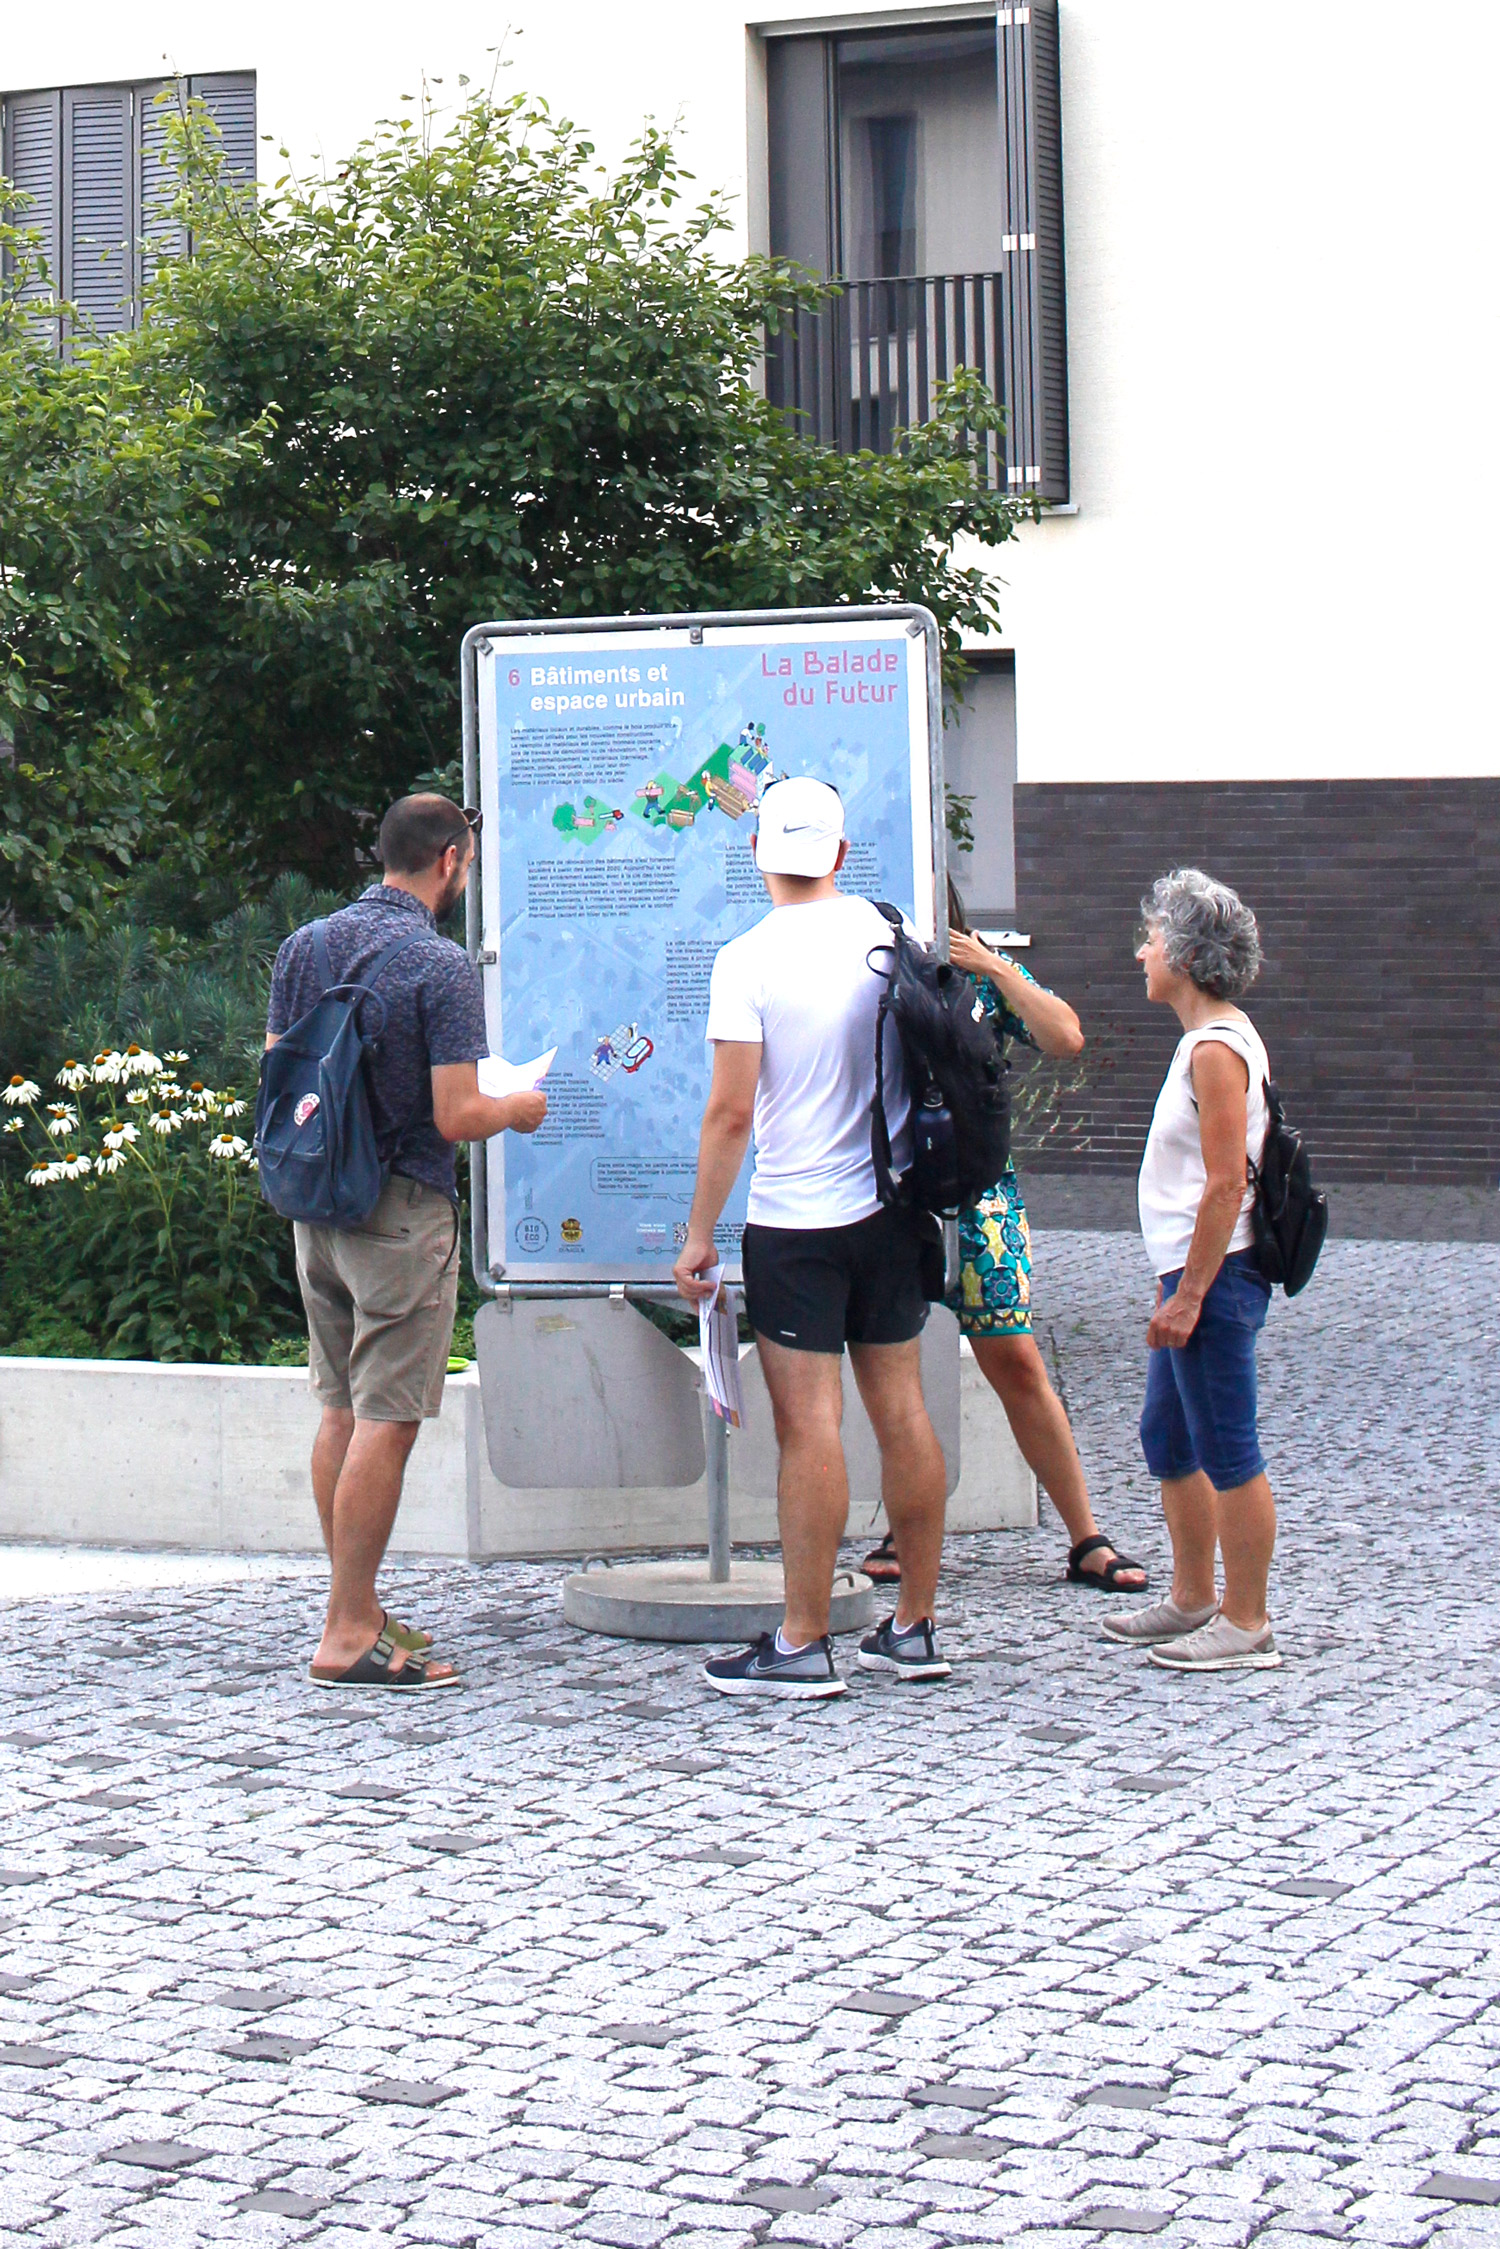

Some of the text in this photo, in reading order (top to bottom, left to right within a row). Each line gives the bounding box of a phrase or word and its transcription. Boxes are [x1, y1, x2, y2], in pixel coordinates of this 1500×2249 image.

[761, 648, 898, 677] La Balade
[508, 669, 520, 686] 6
[530, 664, 668, 686] Bâtiments et
[530, 687, 685, 713] espace urbain
[783, 682, 898, 706] du Futur
